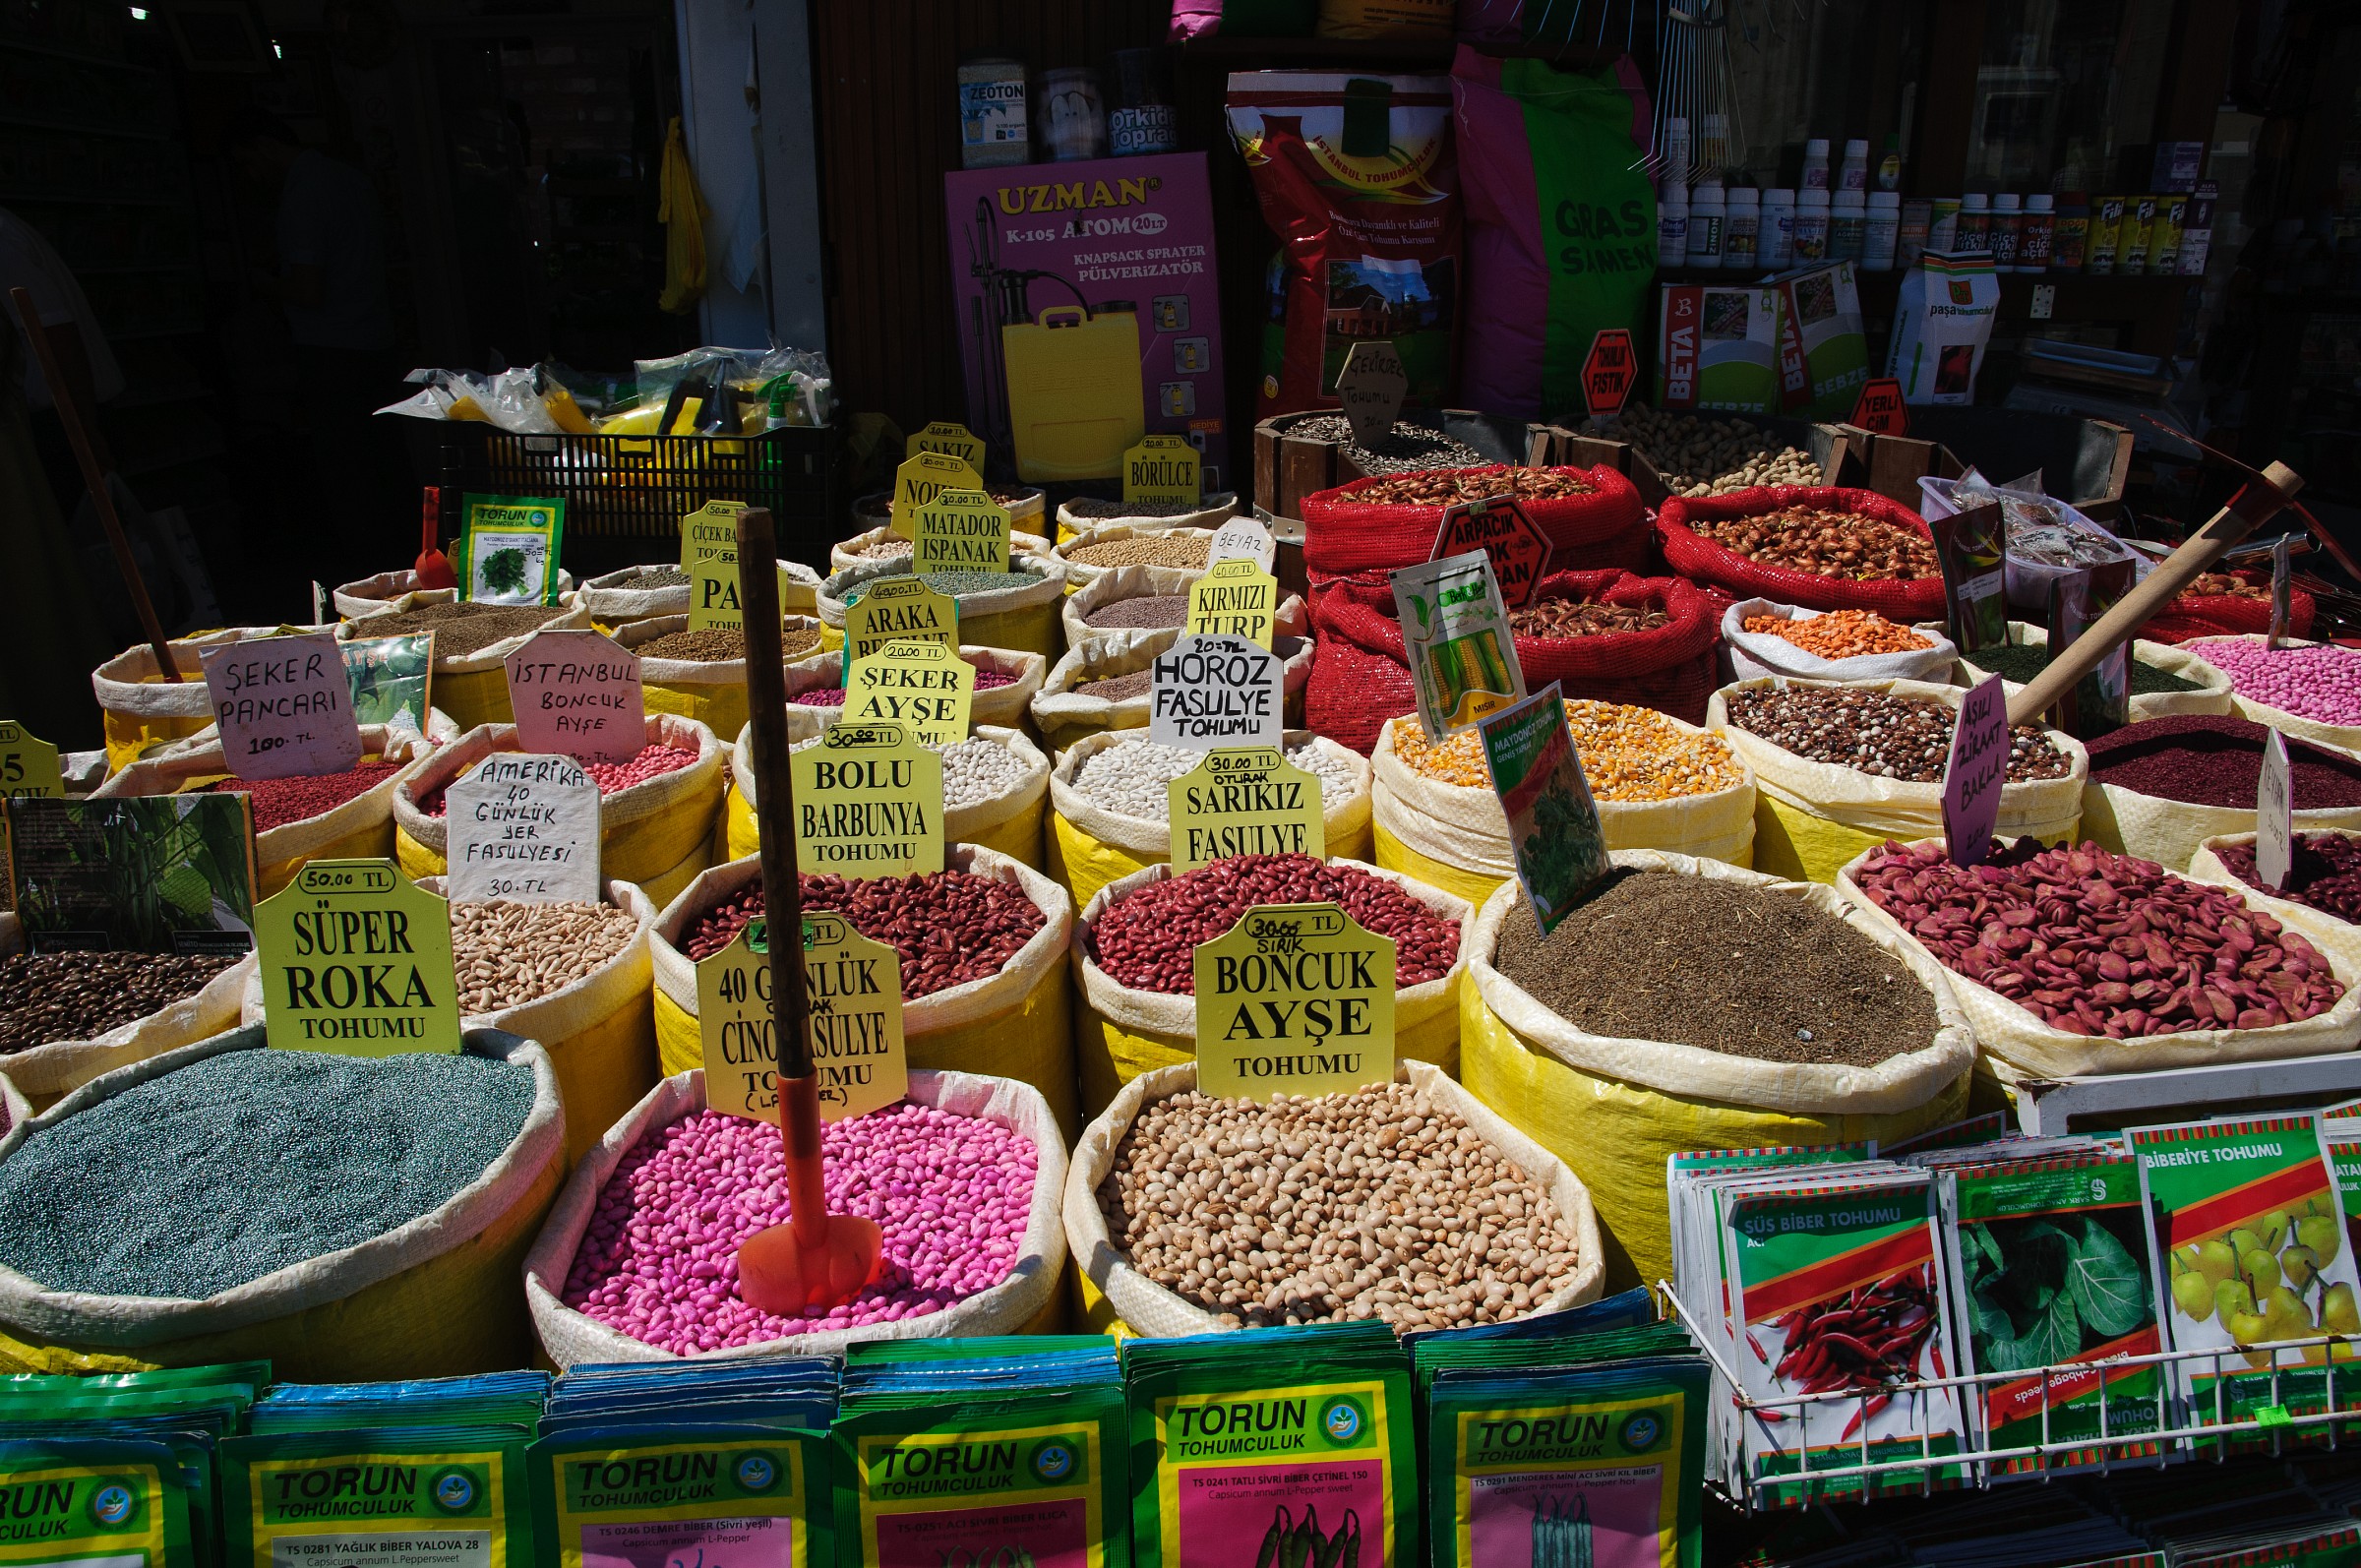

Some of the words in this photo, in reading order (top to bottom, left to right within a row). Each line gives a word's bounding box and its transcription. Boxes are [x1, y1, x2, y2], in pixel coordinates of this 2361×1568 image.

[970, 85, 1024, 100] ZEOTON
[1312, 135, 1362, 181] İSTANBUL
[1366, 139, 1436, 183] TOHUMCULUK
[998, 176, 1148, 215] UZMAN
[1006, 229, 1056, 244] K-105
[1062, 216, 1131, 239] ATOM
[1555, 199, 1648, 240] GRAS
[1073, 249, 1143, 266] KNAPSACK
[1146, 245, 1206, 263] SPRAYER
[1930, 305, 1957, 320] paşa
[1667, 326, 1695, 400] BETA
[1781, 318, 1806, 393] BETA
[1592, 371, 1626, 394] FISTIK
[1813, 366, 1869, 398] SEBZE
[1864, 395, 1900, 413] YERLİ
[954, 427, 965, 436] TL
[949, 461, 961, 470] TL
[1131, 454, 1193, 487] BÖRÜLCE
[971, 496, 984, 505] TL
[1136, 494, 1187, 505] TOHUMU
[479, 509, 527, 520] TORUN
[922, 513, 1001, 537] MATADOR
[693, 522, 724, 544] ÇİÇEK
[1455, 513, 1517, 545] ARPACIK
[923, 538, 1000, 563] ISPANAK
[1219, 532, 1261, 552] BEYAZ
[1241, 564, 1252, 573] TL
[1198, 584, 1267, 612] KIRMIZI
[865, 603, 939, 633] ARAKA
[1195, 615, 1266, 639] TURP
[926, 648, 941, 658] TL
[224, 653, 326, 696] ŞEKER
[515, 658, 637, 684] İSTANBUL
[862, 667, 959, 691] ŞEKER
[1154, 653, 1273, 687] HOROZ
[219, 691, 337, 728] PANCARI
[540, 691, 627, 710] BONCUK
[858, 694, 957, 725] AYŞE
[1156, 689, 1272, 717] FASULYE
[1473, 699, 1496, 714] MISIR
[557, 716, 608, 736] AYŞE
[877, 731, 896, 743] TL
[1173, 717, 1261, 737] TOHUMU
[1493, 722, 1537, 753] MAYDONOZ
[1255, 754, 1276, 767] TL
[480, 759, 585, 787] AMERİKA
[813, 759, 915, 790] BOLU
[1961, 754, 2000, 813] BAKLA
[507, 785, 530, 807] 40
[1186, 782, 1304, 815] SARIKIZ
[475, 802, 556, 825] GÜNLÜK
[801, 802, 928, 838] BARBUNYA
[502, 825, 539, 840] YER
[1186, 822, 1308, 862] FASULYE
[466, 841, 576, 863] FASULYESİ
[813, 842, 917, 862] TOHUMU
[305, 871, 353, 886] 50.00
[363, 872, 390, 887] TL
[293, 899, 415, 956] SÜPER
[1312, 915, 1338, 931] TL
[719, 967, 747, 1003] 40
[755, 950, 881, 1001] GNLÜK
[1214, 950, 1377, 995] BONCUK
[282, 963, 437, 1010] ROKA
[299, 1016, 426, 1039] TOHUMU
[1222, 997, 1372, 1047] AYŞE
[1233, 1053, 1362, 1078] TOHUMU
[742, 1063, 874, 1093] TOUMU
[2145, 1146, 2210, 1170] BİBERİYE
[2211, 1142, 2283, 1164] TOHUMU
[1744, 1209, 1776, 1235] SÜS
[1780, 1211, 1827, 1232] BİBER
[1830, 1207, 1902, 1226] TOHUMU
[1746, 1236, 1765, 1249] ACI
[1178, 1399, 1307, 1437] TORUN
[1479, 1415, 1609, 1449] TORUN
[1179, 1433, 1306, 1457] TOHUMCULUK
[1478, 1444, 1604, 1464] TOHUMCULUK
[577, 1453, 718, 1490] TORUN
[880, 1442, 1018, 1478] TORUN
[274, 1466, 418, 1500] TORUN
[880, 1474, 1015, 1496] TOHUMCULUK
[1192, 1478, 1204, 1487] TS
[1206, 1478, 1229, 1486] 0241
[1231, 1476, 1256, 1486] TATLI
[1258, 1473, 1281, 1484] SİVRİ
[1284, 1472, 1310, 1483] BİBER
[1312, 1471, 1349, 1484] ÇETİNEL
[1352, 1470, 1368, 1480] 150
[1486, 1476, 1506, 1486] 0291
[1508, 1472, 1554, 1483] MENDERES
[1577, 1471, 1594, 1479] ACI
[1633, 1466, 1657, 1476] BİBER
[1493, 1483, 1538, 1496] Capsicum
[1540, 1480, 1574, 1491] annum
[578, 1482, 716, 1508] TOHUMCULUK
[1208, 1488, 1251, 1500] Capsicum
[1254, 1487, 1285, 1497] annum
[1327, 1483, 1354, 1494] sweet
[276, 1498, 416, 1519] TOHUMCULUK
[599, 1528, 612, 1537] TS
[615, 1526, 640, 1536] 0246
[642, 1524, 681, 1535] DEMRE
[684, 1520, 714, 1532] BİBER
[286, 1545, 301, 1555] TS
[303, 1544, 332, 1555] 0281
[334, 1540, 378, 1554] YAĞLIK
[380, 1539, 412, 1552] BİBER
[415, 1539, 463, 1552] YALOVA
[465, 1539, 479, 1550] 28
[623, 1537, 669, 1548] Capsicum
[671, 1535, 705, 1545] annum
[307, 1556, 353, 1568] Capsicum
[355, 1555, 390, 1566] annum
